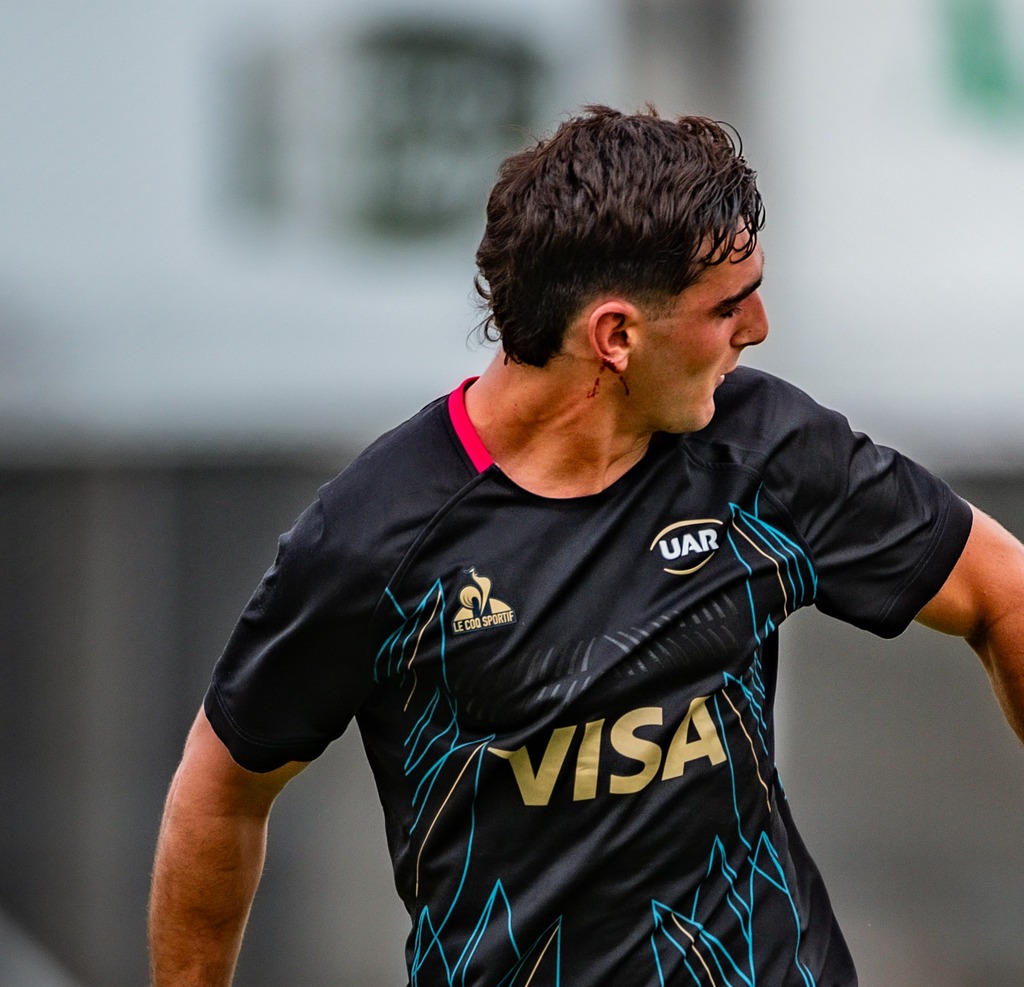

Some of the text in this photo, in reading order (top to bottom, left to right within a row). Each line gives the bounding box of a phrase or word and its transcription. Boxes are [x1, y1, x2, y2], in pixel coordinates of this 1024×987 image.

[659, 528, 720, 560] UAR
[453, 610, 514, 632] LE COQ SPORTIF
[487, 695, 727, 806] VISA
